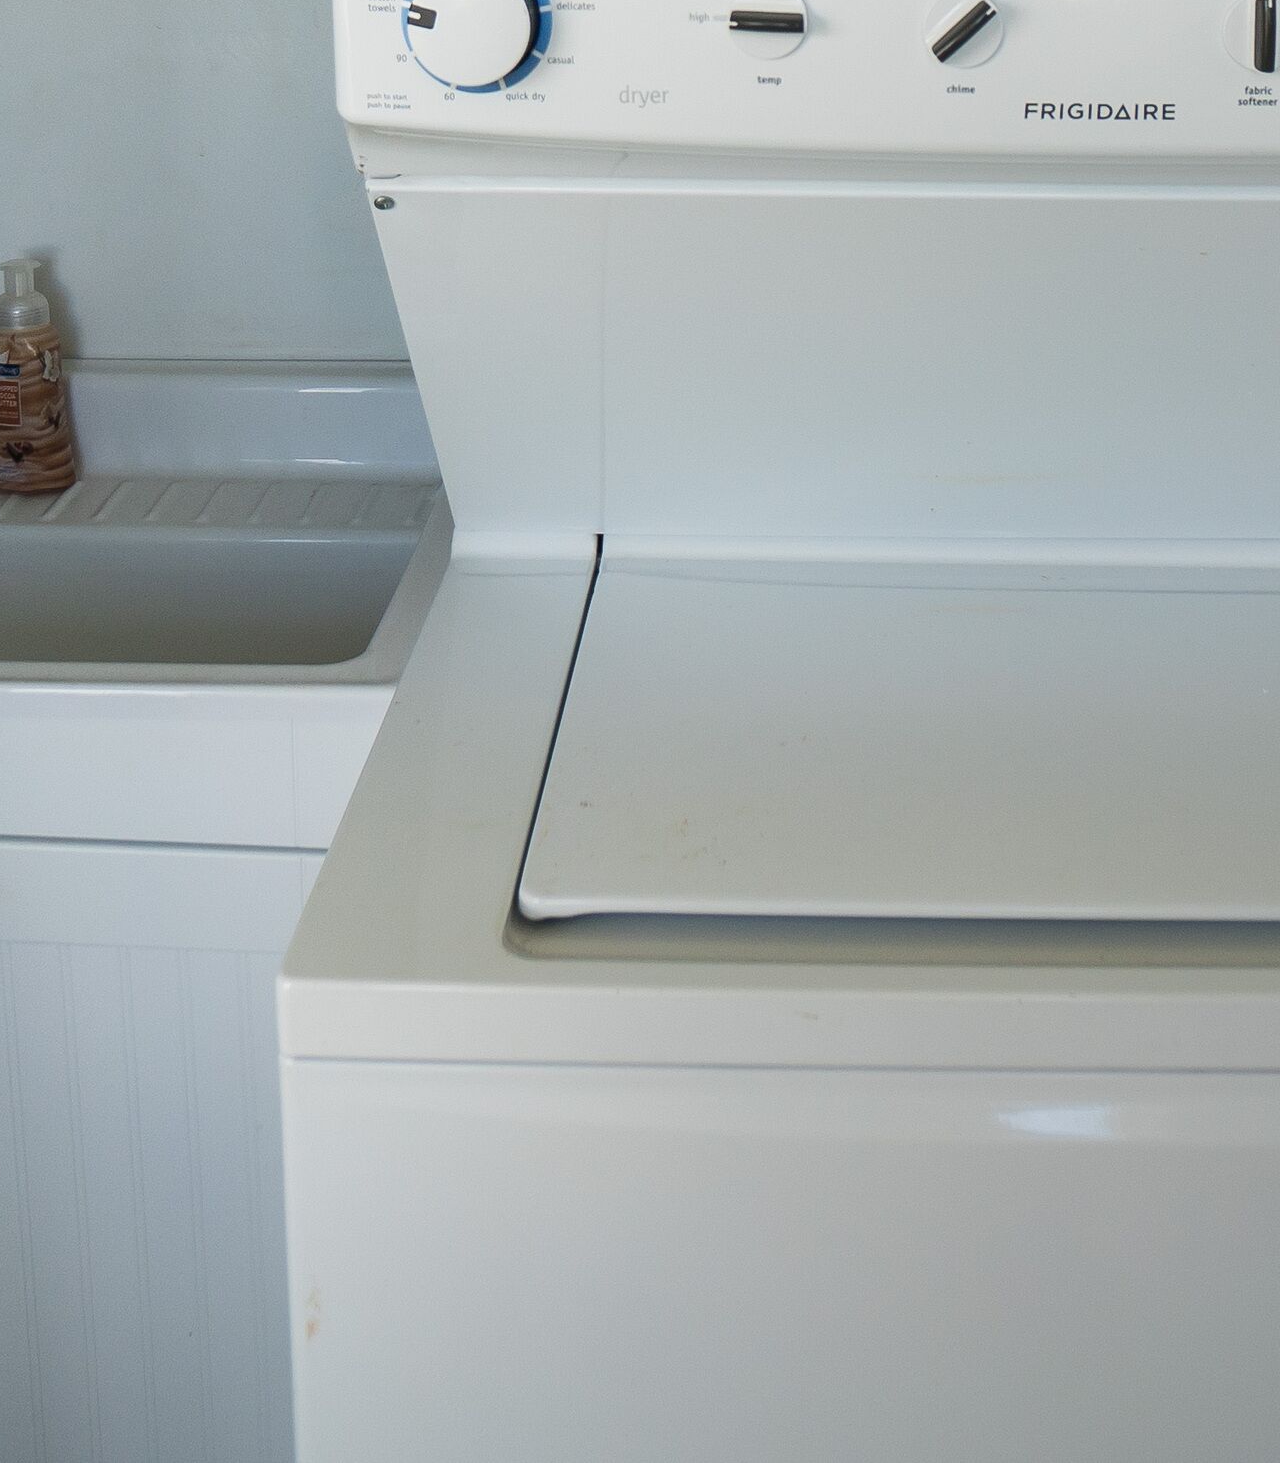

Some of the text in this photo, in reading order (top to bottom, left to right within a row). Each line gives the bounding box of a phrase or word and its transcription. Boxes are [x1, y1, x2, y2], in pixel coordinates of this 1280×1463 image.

[368, 3, 396, 13] towels
[556, 2, 596, 11] delicates
[689, 13, 710, 24] high
[396, 54, 408, 63] 90
[547, 55, 575, 65] casual
[757, 75, 782, 85] temp
[946, 84, 976, 94] chime
[1245, 86, 1272, 95] fabric
[443, 92, 455, 101] 60
[505, 92, 546, 103] quick dry
[619, 85, 669, 108] dryer
[1238, 97, 1278, 106] softener
[1024, 102, 1176, 120] FRIGIDAIRE
